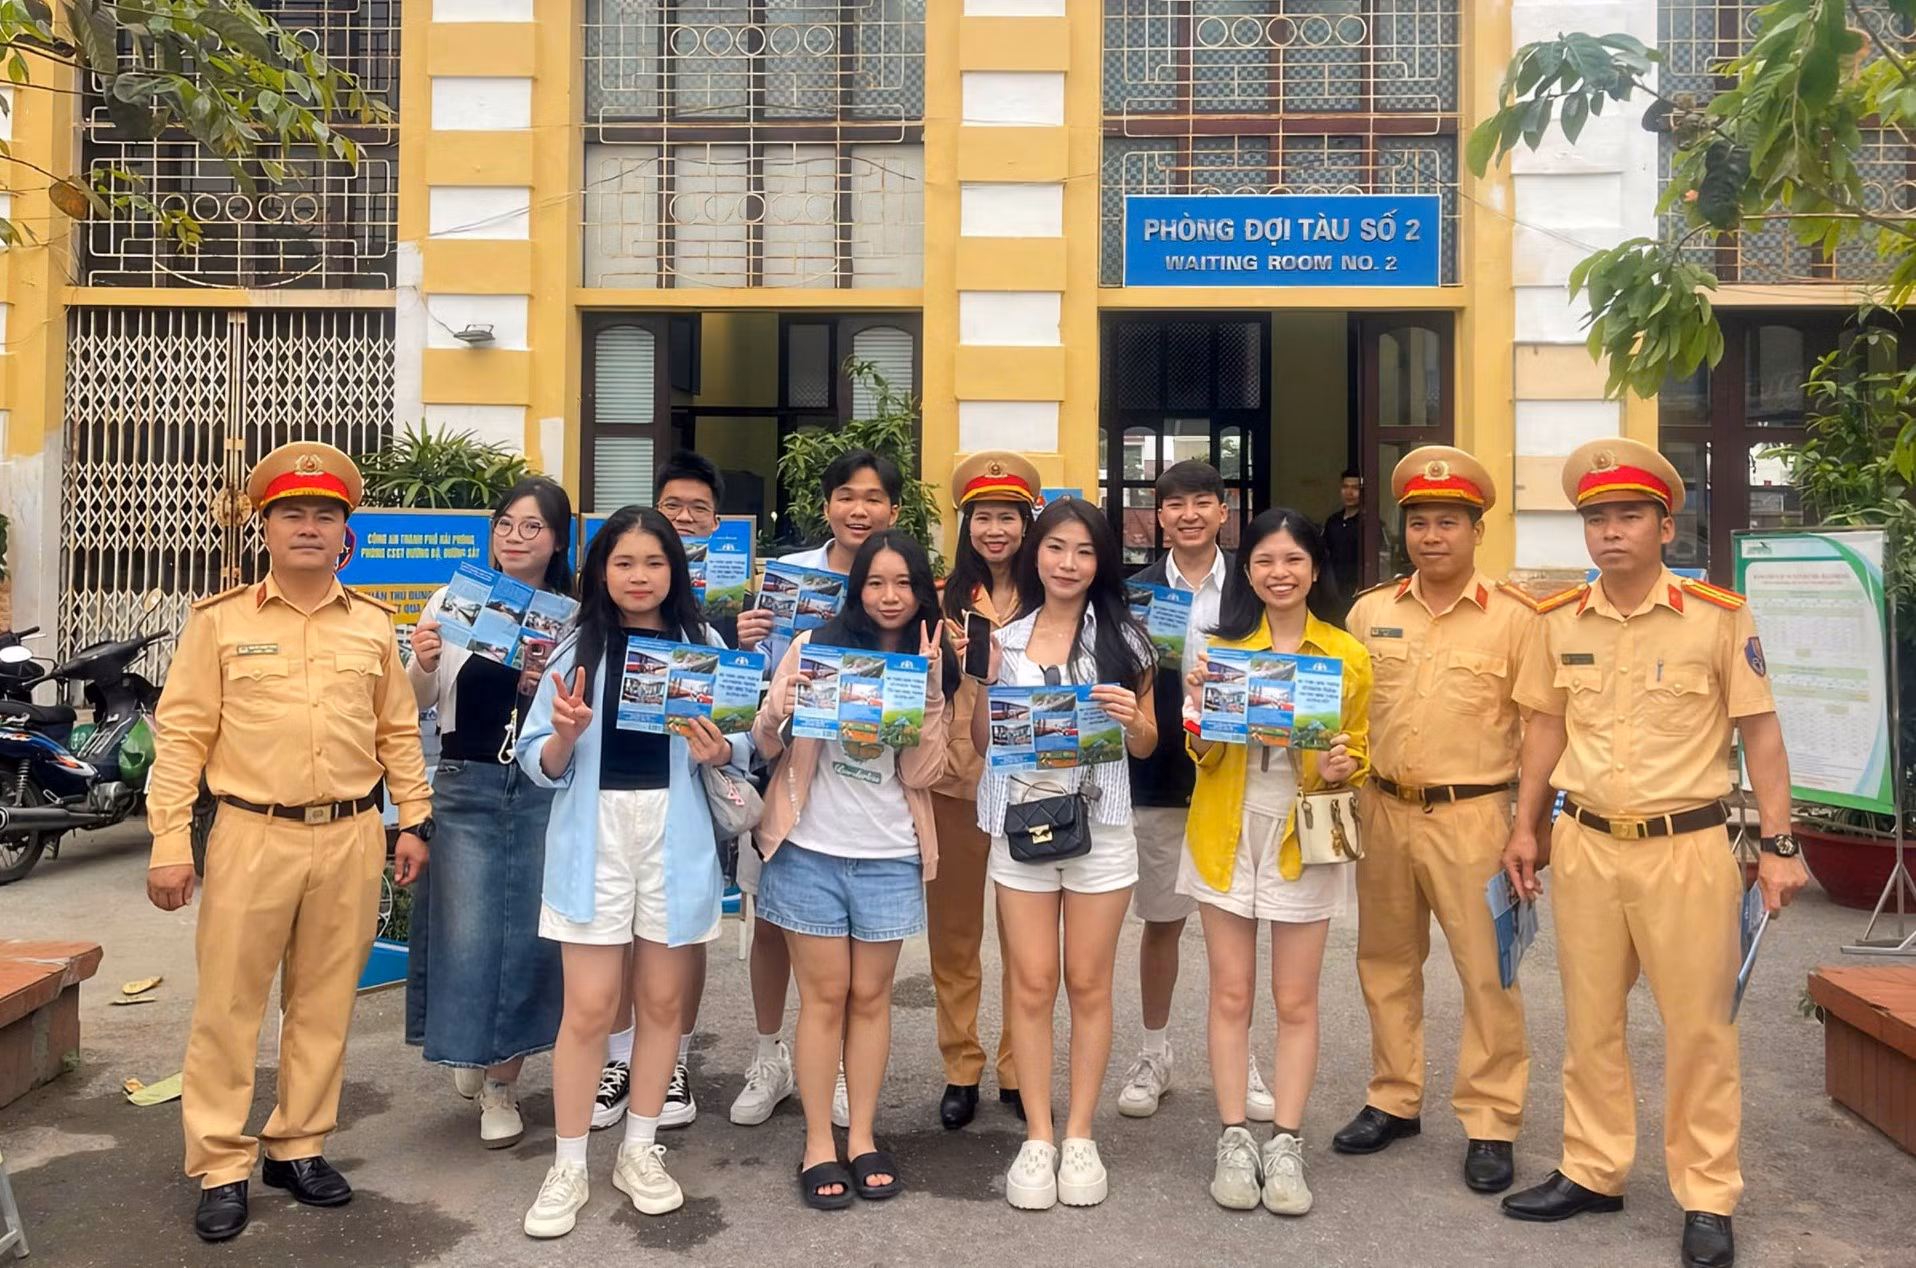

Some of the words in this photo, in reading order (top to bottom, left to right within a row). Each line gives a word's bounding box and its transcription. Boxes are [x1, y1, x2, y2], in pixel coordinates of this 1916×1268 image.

[1143, 212, 1234, 242] PHÒNG
[1244, 218, 1291, 247] ĐỢI
[1298, 212, 1350, 242] TÀU
[1360, 208, 1399, 242] SỐ
[1405, 219, 1421, 241] 2
[1164, 255, 1258, 271] WAITING
[1267, 255, 1333, 271] ROOM
[1341, 255, 1380, 271] NO.
[1385, 255, 1399, 271] 2
